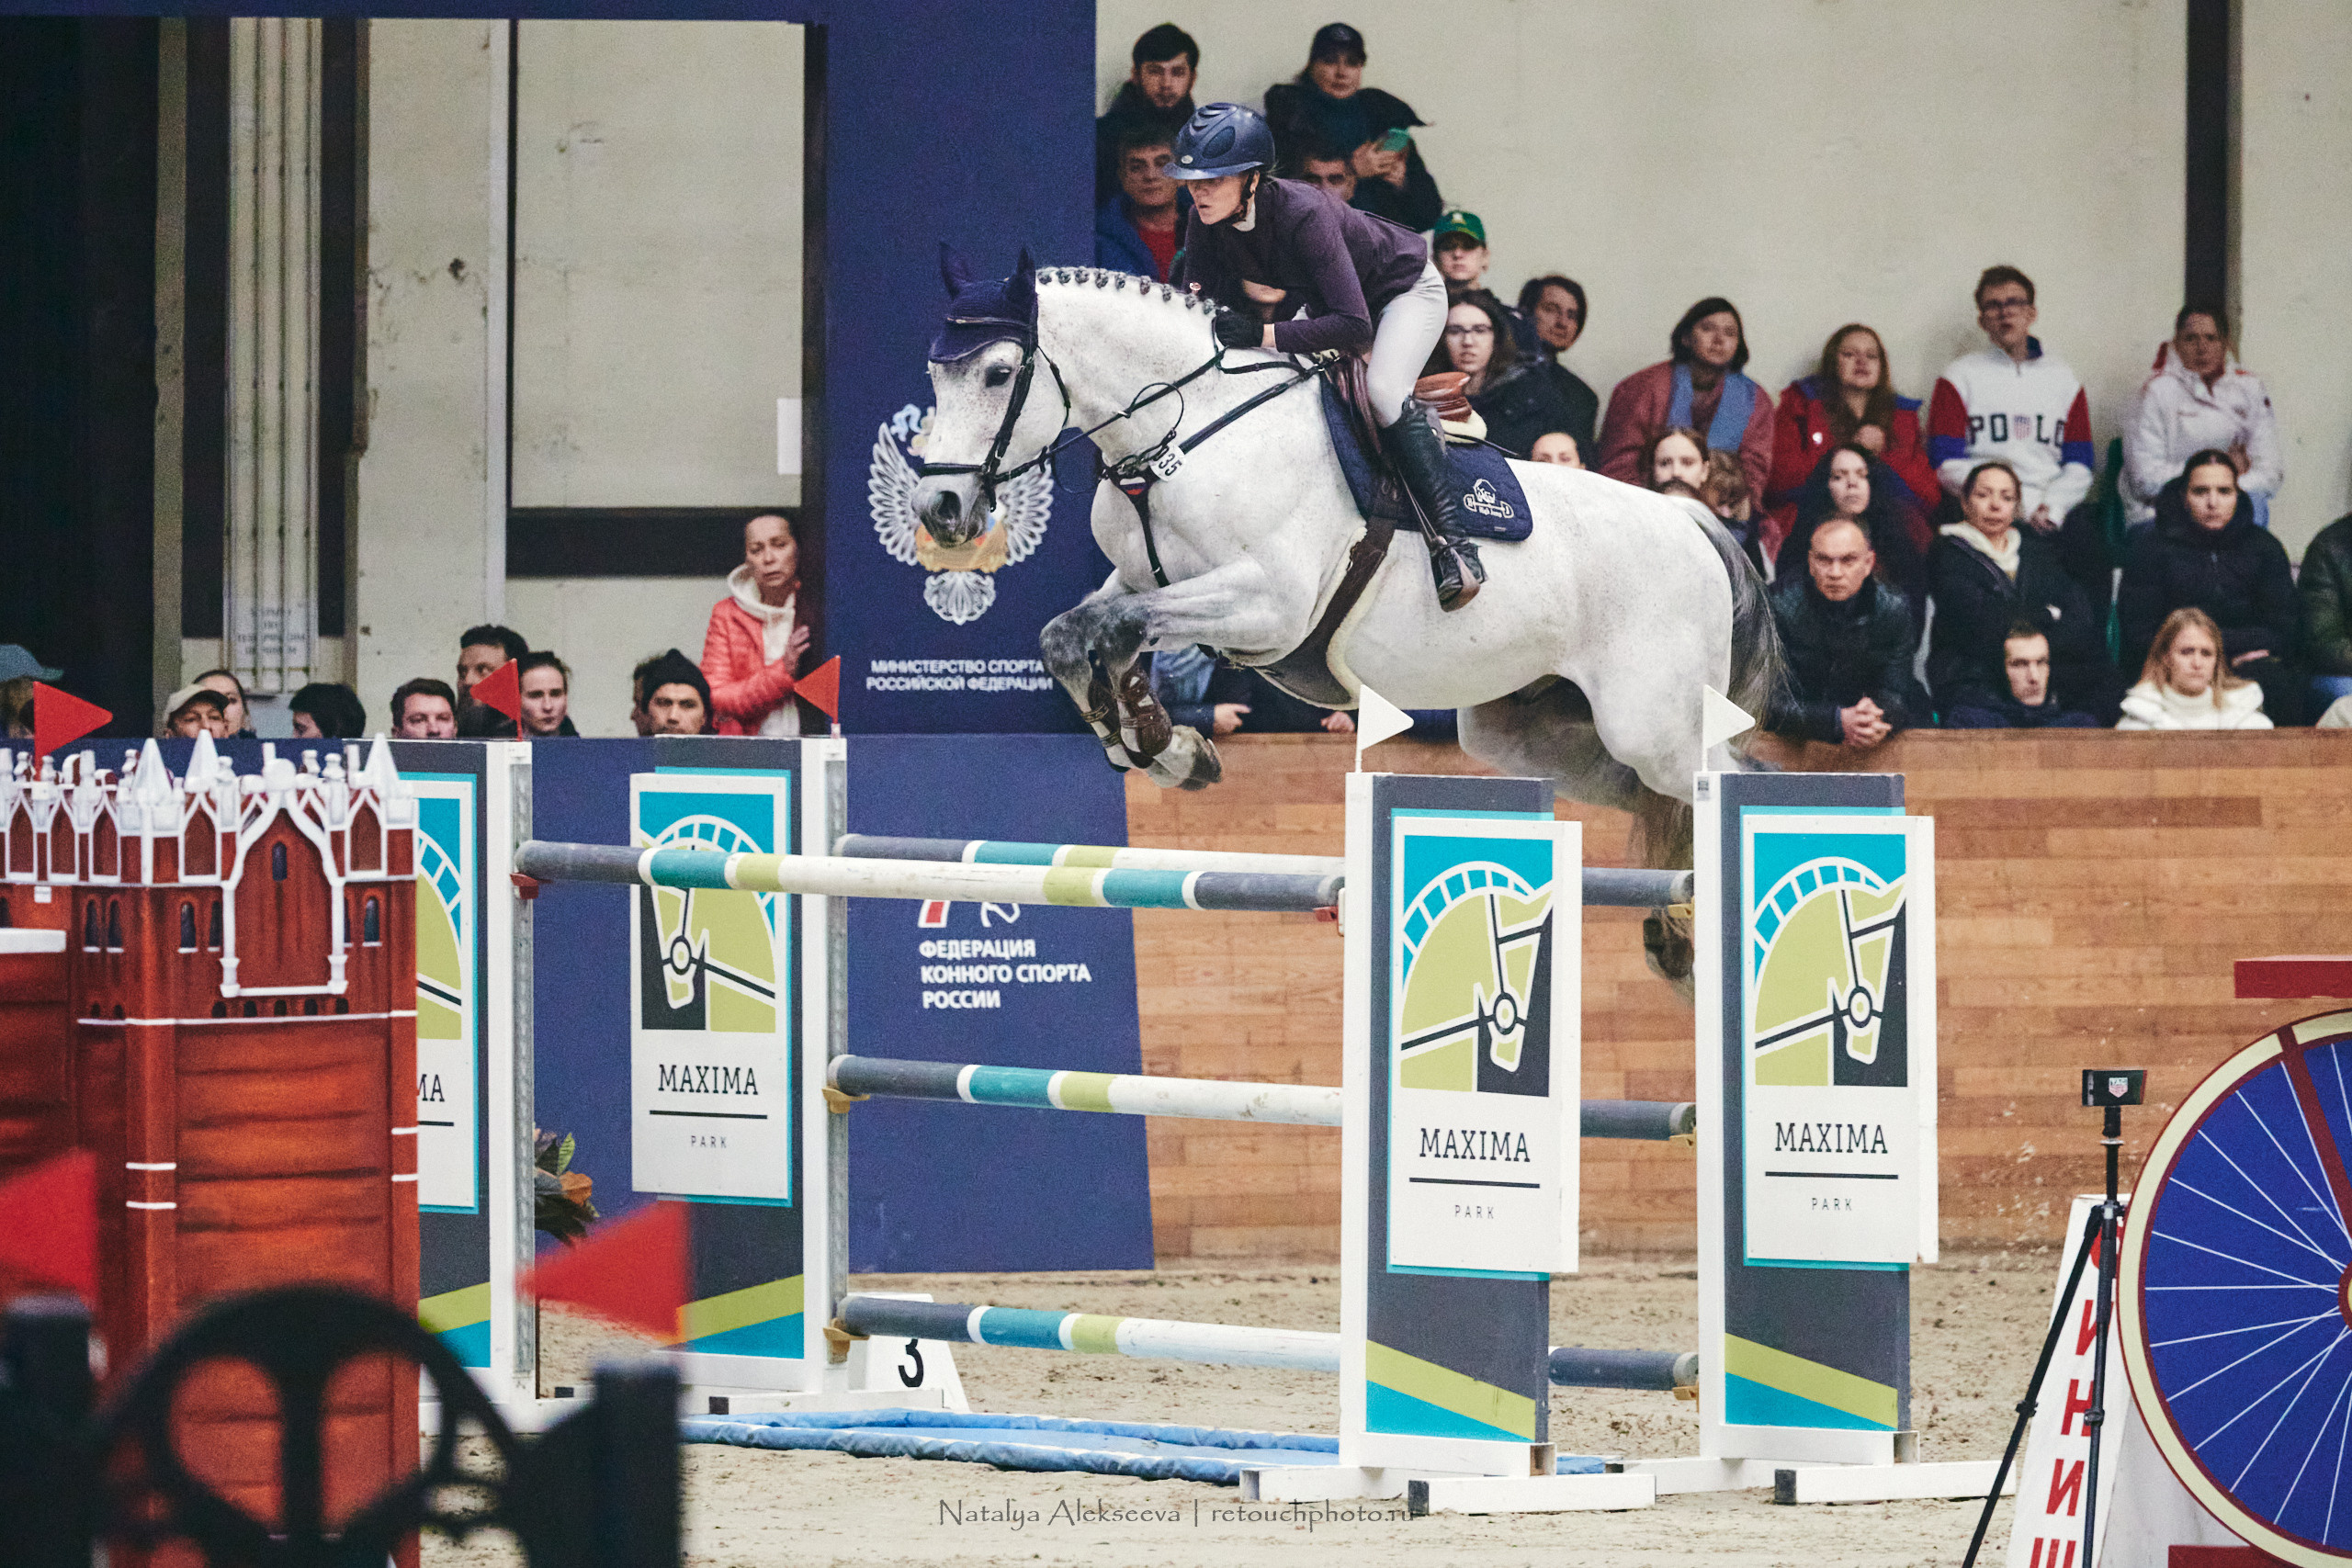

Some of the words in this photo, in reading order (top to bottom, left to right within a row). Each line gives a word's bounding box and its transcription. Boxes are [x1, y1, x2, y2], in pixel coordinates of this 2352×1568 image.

[871, 660, 987, 674] МИНИСТЕРСТВО
[988, 660, 1045, 674] СПОРТА
[866, 675, 966, 691] РОССИЙСКОЙ
[967, 676, 1054, 693] ФЕДЕРАЦИИ
[919, 939, 1036, 961] ФЕДЕРАЦИЯ
[921, 964, 1012, 984] КОННОГО
[1015, 964, 1092, 984] СПОРТА
[922, 990, 1001, 1010] РОССИИ
[658, 1064, 759, 1095] MAXIMA
[691, 1135, 727, 1149] PARK
[1419, 1127, 1531, 1163] MAXIMA
[1775, 1122, 1889, 1154] MAXIMA
[1454, 1204, 1495, 1220] PARK
[1812, 1197, 1852, 1212] PARK
[898, 1337, 924, 1388] 3
